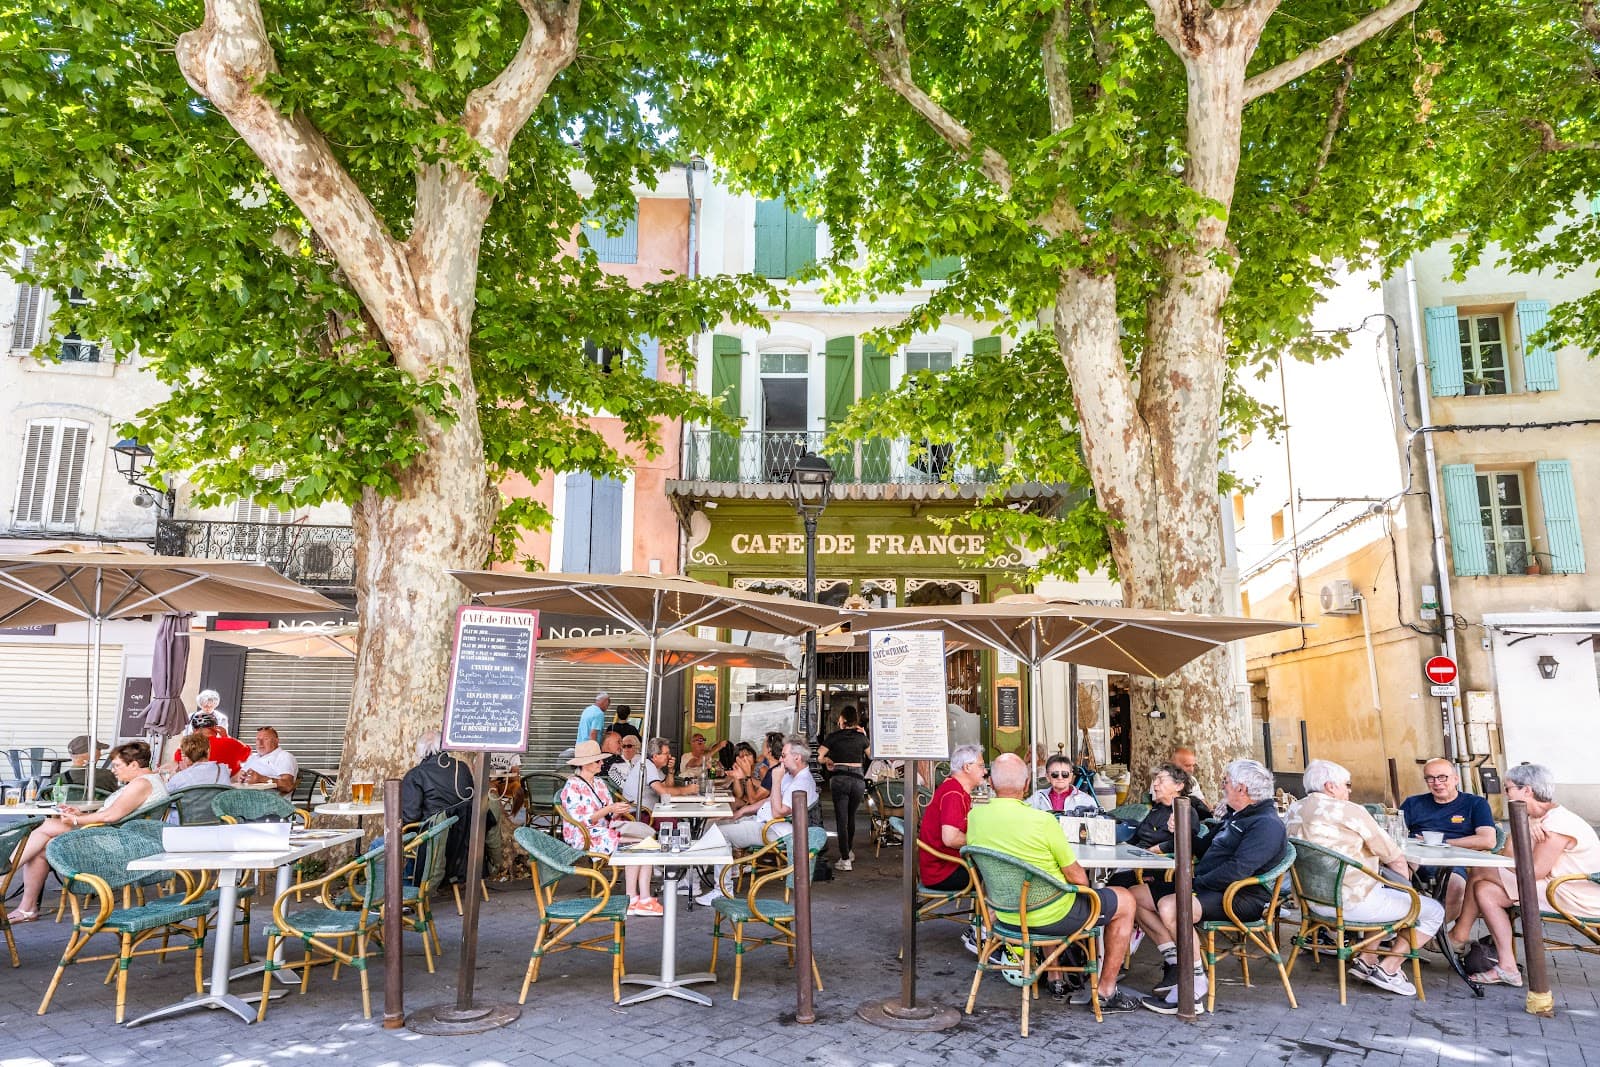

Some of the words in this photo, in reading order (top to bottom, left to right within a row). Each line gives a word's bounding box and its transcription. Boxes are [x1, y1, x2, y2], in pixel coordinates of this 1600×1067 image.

[731, 534, 805, 554] CAFE
[816, 534, 854, 554] DE
[867, 535, 985, 555] FRANCE
[463, 612, 483, 623] CAFÉ
[487, 615, 497, 624] de
[500, 615, 534, 627] FRANCE
[890, 644, 910, 656] FRANCE
